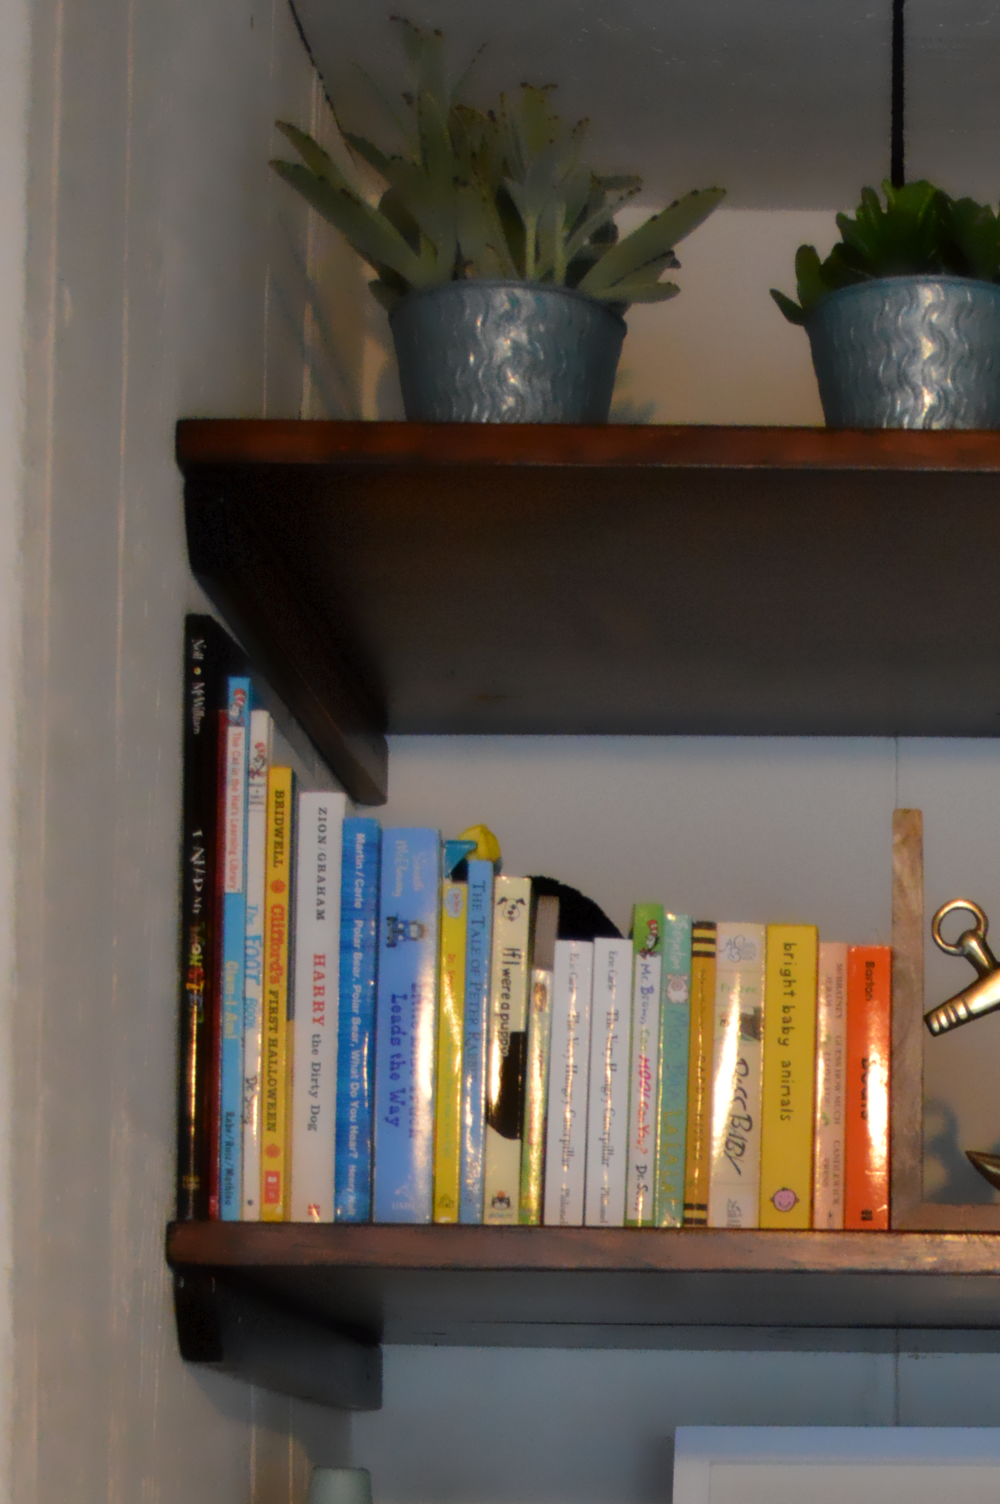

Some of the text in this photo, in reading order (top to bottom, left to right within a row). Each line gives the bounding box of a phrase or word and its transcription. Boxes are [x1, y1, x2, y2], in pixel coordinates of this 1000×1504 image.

[227, 818, 241, 856] Learning
[273, 789, 287, 868] BRIDWELL
[227, 858, 240, 890] Library
[353, 832, 367, 910] Martin Carle
[469, 881, 487, 1024] THE TALE OF PETER
[502, 947, 522, 959] If
[640, 963, 652, 983] Mr.
[499, 1001, 512, 1011] a
[500, 967, 514, 1000] were
[864, 960, 876, 1002] Barton
[266, 903, 286, 1133] Clifford's FIRST HALLOWEEN
[306, 953, 327, 1132] HARRY the Dirty Dog
[347, 920, 364, 1159] Polar Bear, Polar Bear, What Do You Hear?
[777, 942, 798, 1121] bright baby animals
[385, 993, 408, 1127] Leads the Way
[636, 1054, 652, 1098] MOO!
[724, 1113, 753, 1176] BABY
[635, 1164, 649, 1181] Dr.
